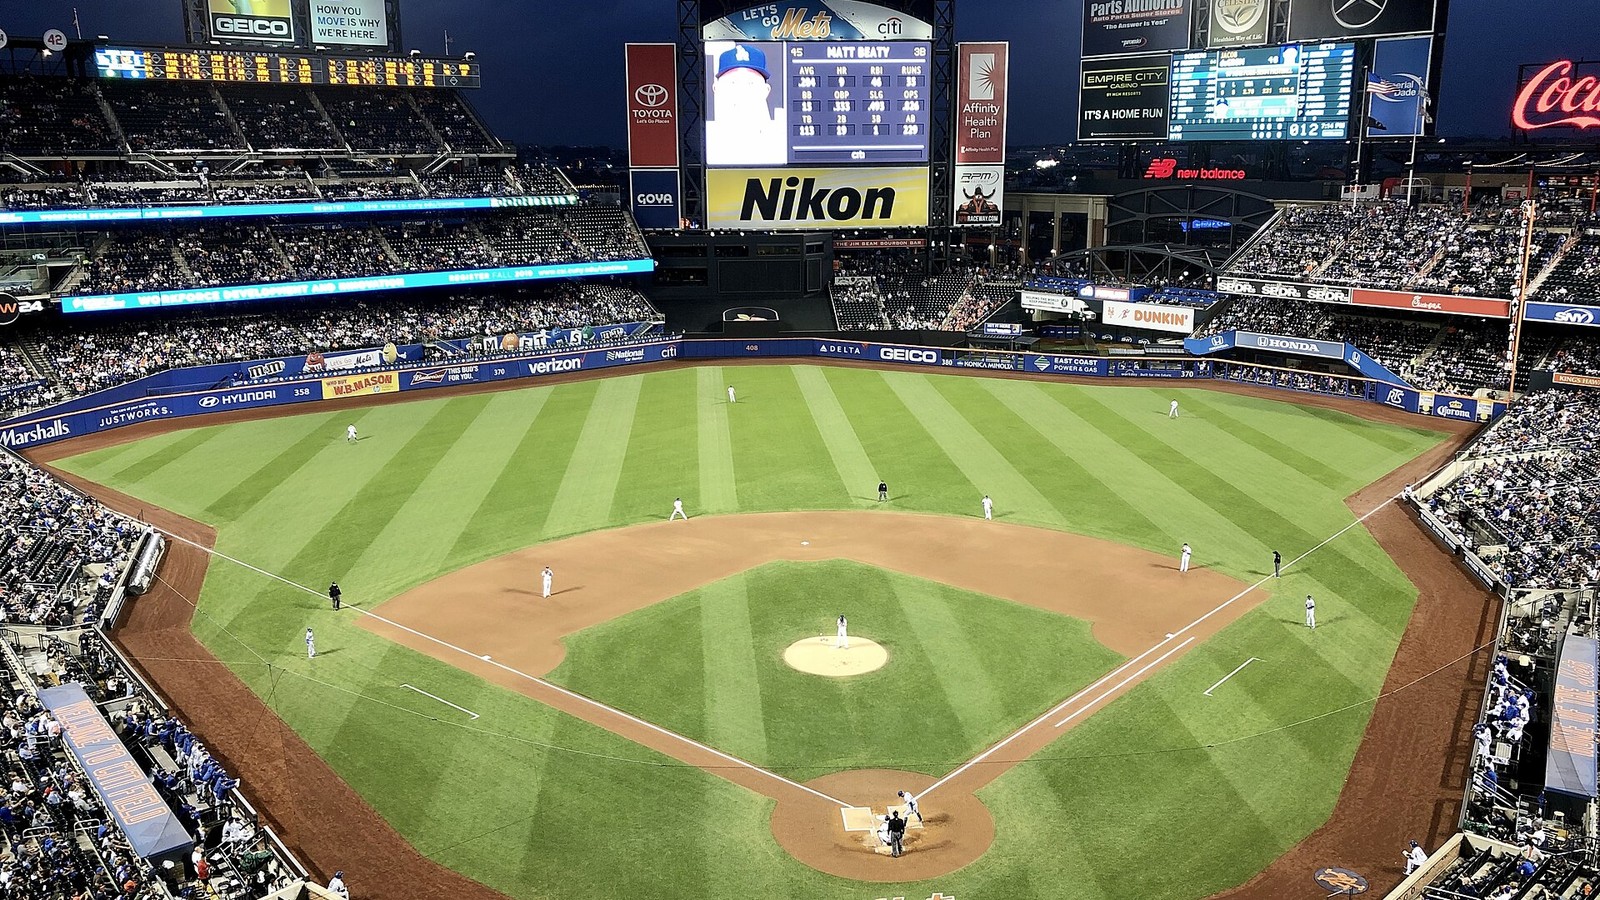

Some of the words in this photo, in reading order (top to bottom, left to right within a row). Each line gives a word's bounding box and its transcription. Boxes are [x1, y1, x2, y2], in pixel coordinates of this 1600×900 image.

[317, 6, 339, 14] HOW
[742, 5, 777, 21] LET'S
[1091, 1, 1122, 16] Parts
[216, 18, 288, 35] GEICO
[318, 17, 345, 26] MOVE
[359, 19, 380, 27] WHY
[762, 16, 779, 27] GO
[771, 8, 831, 38] Mets
[878, 18, 902, 34] citi
[48, 34, 63, 45] 42
[319, 28, 348, 37] WE'RE
[350, 30, 377, 39] HERE.
[791, 48, 803, 56] 45
[827, 47, 855, 58] MATT
[1088, 74, 1132, 83] EMPIRE
[1135, 72, 1162, 80] CITY
[632, 110, 672, 118] TOYOTA
[963, 103, 1000, 115] Affinity
[1084, 110, 1101, 120] IT'S
[1103, 110, 1109, 119] A
[1112, 109, 1140, 119] HOME
[1143, 108, 1163, 118] RUN
[964, 117, 997, 126] Health
[873, 126, 879, 135] 1
[970, 129, 990, 138] Plan
[1177, 170, 1199, 179] new
[1200, 168, 1246, 179] balance
[637, 193, 673, 204] GOYA
[740, 176, 895, 220] Nikon
[449, 272, 490, 282] REGISTER
[138, 290, 220, 306] WORKFORCE
[18, 301, 44, 313] 24
[1134, 310, 1188, 327] DUNKIN'
[1554, 312, 1586, 322] SNY
[662, 347, 676, 357] citi
[830, 345, 860, 354] DELTA
[1269, 340, 1319, 352] HONDA
[615, 348, 644, 359] National
[880, 348, 936, 363] GEICO
[529, 358, 582, 374] verizon
[988, 361, 1014, 369] MINOLTA
[222, 390, 276, 404] HYUNDAI
[294, 388, 310, 396] 358
[100, 407, 172, 426] JUSTWORKS.
[1437, 405, 1470, 418] Corona
[0, 420, 69, 446] Marshalls
[53, 700, 114, 749] WELCOME
[83, 744, 126, 766] TO
[93, 761, 144, 790] CITI
[108, 784, 167, 825] FIELD
